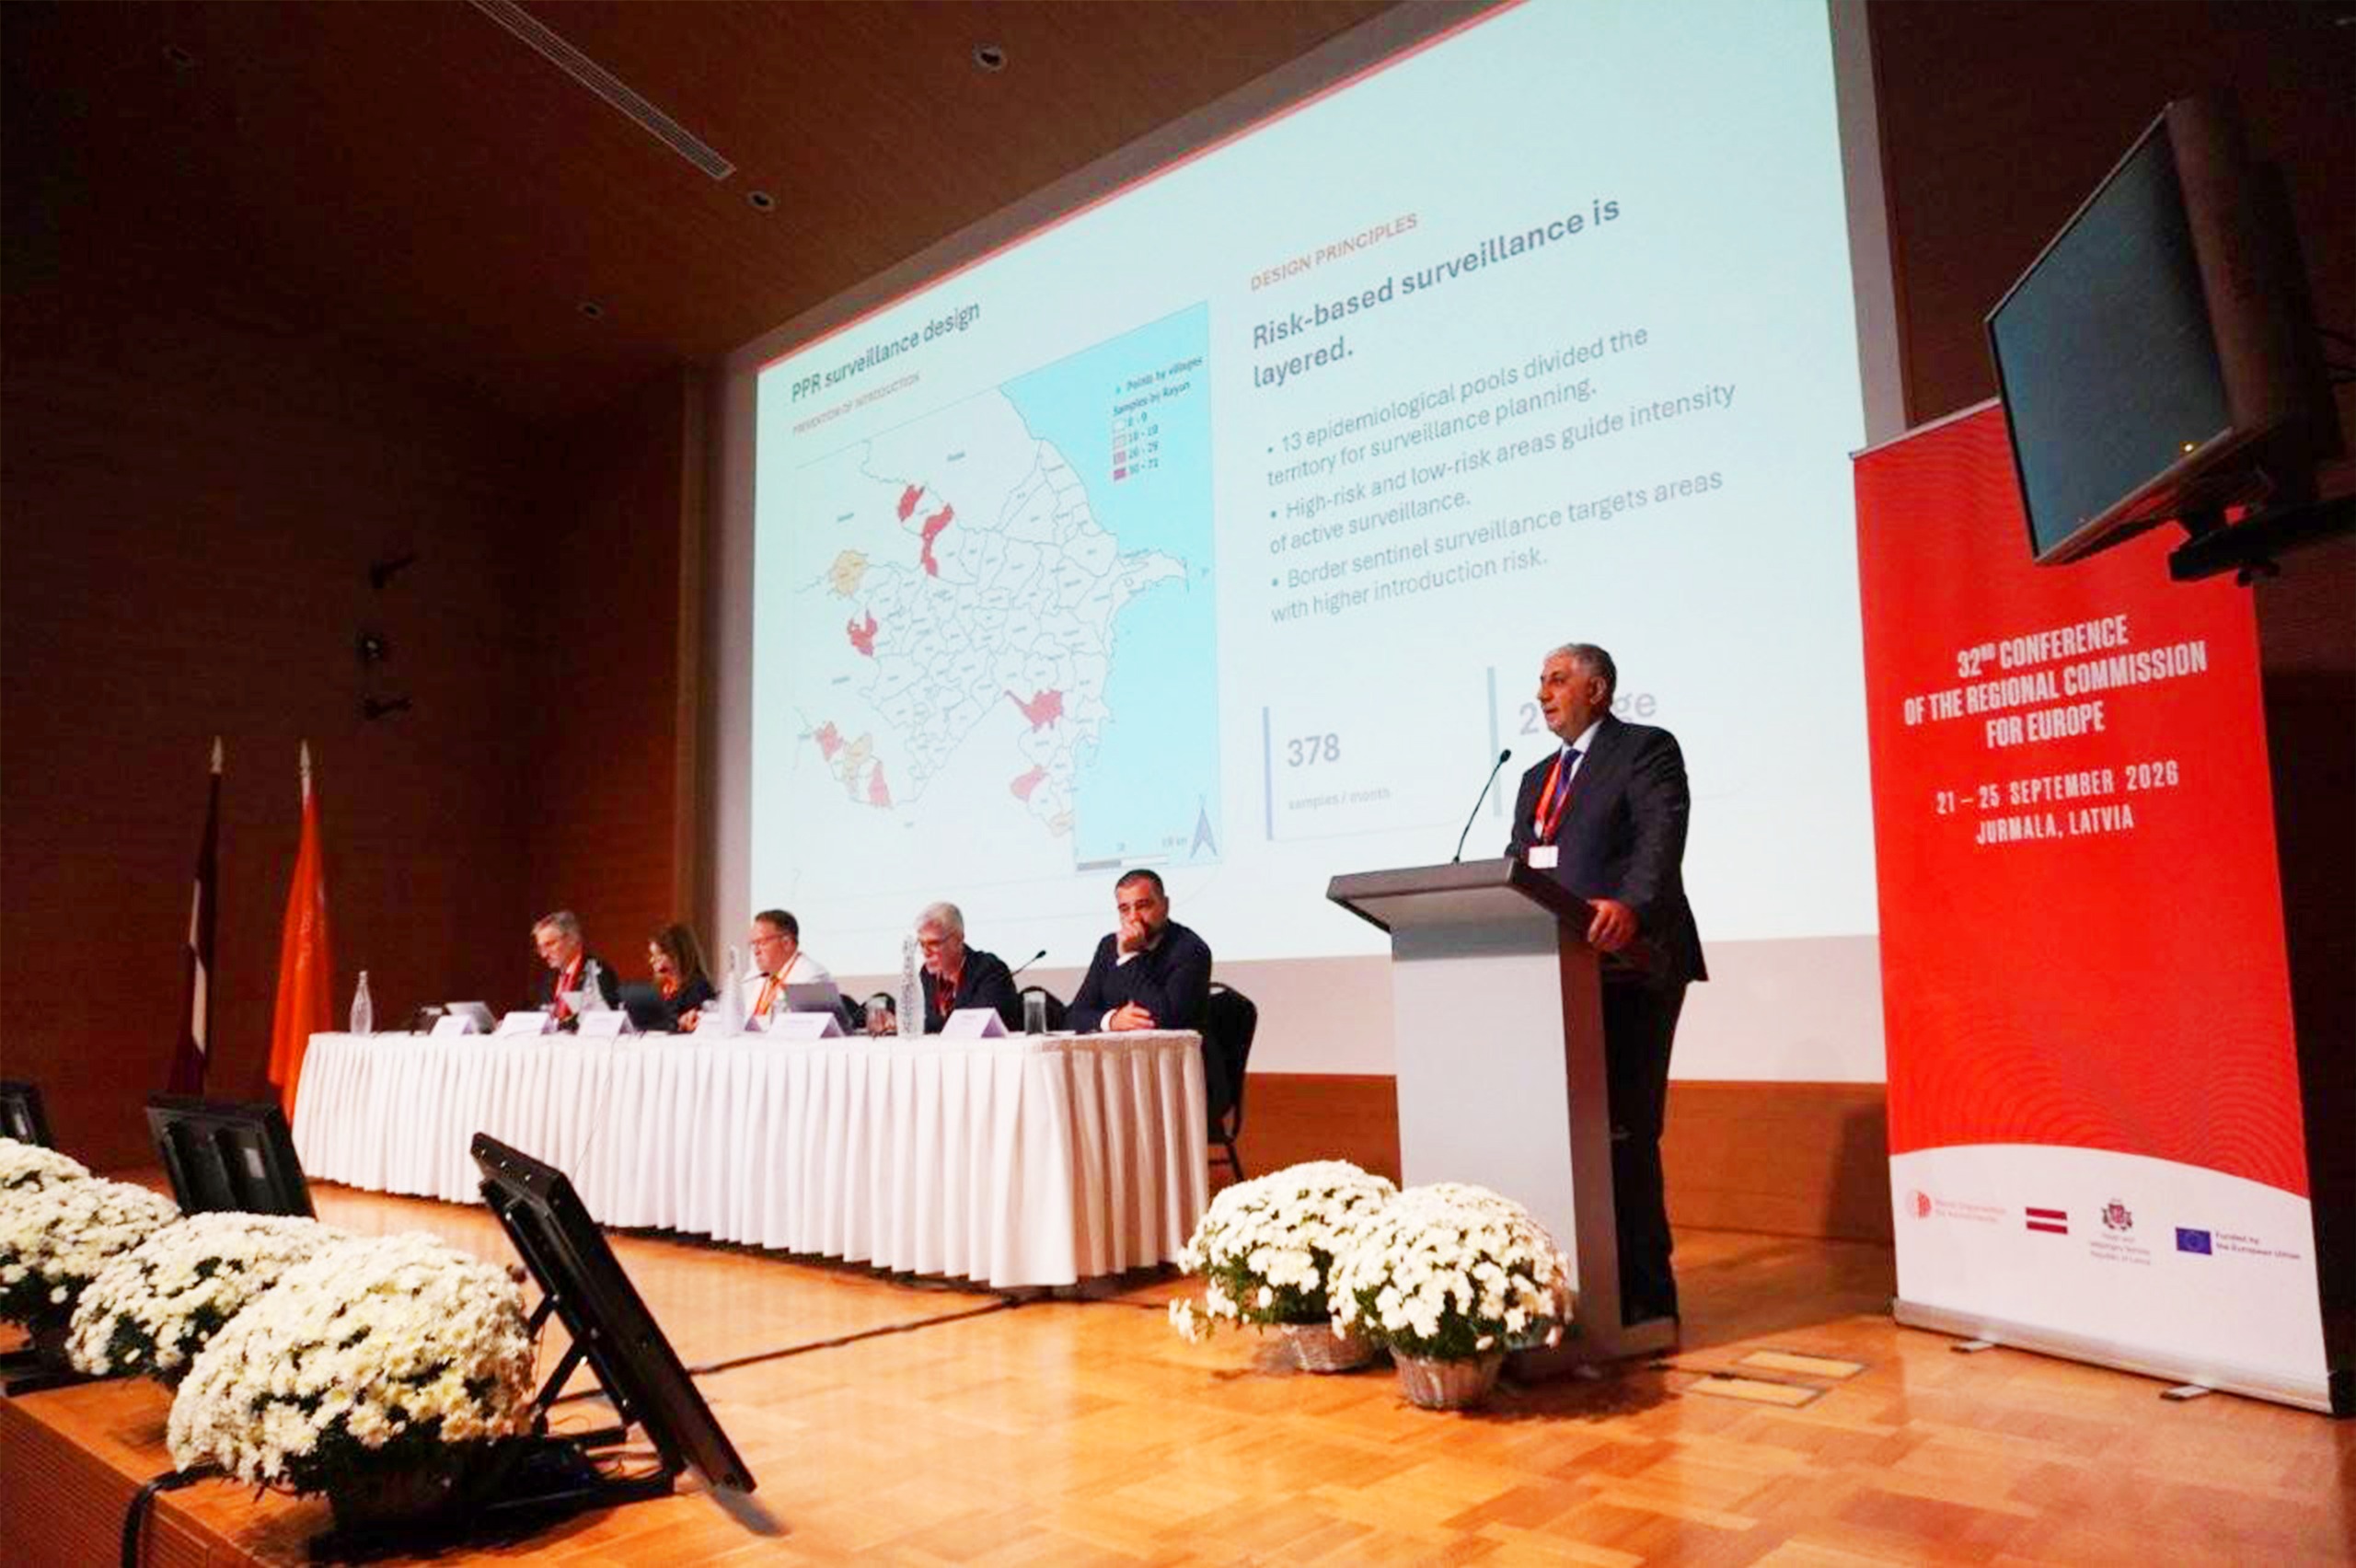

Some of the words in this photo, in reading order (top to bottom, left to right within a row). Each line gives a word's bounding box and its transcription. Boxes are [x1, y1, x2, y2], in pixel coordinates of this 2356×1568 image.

[1251, 255, 1311, 291] DESIGN
[1315, 213, 1417, 265] PRINCIPLES
[1253, 277, 1392, 349] Risk-based
[1402, 214, 1583, 294] surveillance
[1594, 201, 1619, 225] is
[791, 373, 821, 402] PPR
[825, 332, 918, 386] surveillance
[924, 303, 979, 341] design
[1254, 335, 1353, 387] layered.
[1282, 432, 1301, 452] 13
[1306, 383, 1455, 446] epidemiological
[1461, 367, 1519, 403] pools
[1524, 338, 1603, 379] divided
[1609, 329, 1647, 352] the
[1267, 455, 1336, 486] territory
[1340, 445, 1366, 465] for
[1370, 409, 1489, 456] surveillance
[1496, 377, 1596, 426] planning.
[1287, 482, 1366, 518] High-risk
[1371, 470, 1406, 497] and
[1411, 449, 1491, 485] low-risk
[1496, 433, 1555, 463] areas
[1562, 414, 1623, 450] guide
[1630, 385, 1735, 427] intensity
[1270, 535, 1287, 554] of
[1290, 524, 1343, 548] active
[1349, 492, 1471, 534] surveillance.
[1288, 559, 1347, 588] Border
[1352, 537, 1428, 572] sentinel
[1434, 510, 1562, 553] surveillance
[1568, 490, 1647, 522] targets
[1655, 471, 1723, 502] areas
[1271, 600, 1308, 622] with
[1313, 588, 1369, 615] higher
[1375, 559, 1496, 600] introduction
[1503, 546, 1547, 572] risk.
[2000, 615, 2128, 668] CONFERENCE
[1905, 697, 1923, 725] OF
[1929, 689, 1962, 720] THE
[1967, 671, 2059, 713] REGIONAL
[2063, 641, 2205, 695] COMMISSION
[1288, 732, 1340, 767] 378
[1987, 716, 2023, 747] FOR
[2027, 701, 2104, 741] EUROPE
[1288, 794, 1339, 810] samples
[1350, 787, 1391, 802] month
[1937, 791, 1954, 813] 21
[1979, 784, 1999, 808] 25
[2010, 769, 2113, 804] SEPTEMBER
[2126, 760, 2177, 790] 2026
[1977, 813, 2062, 844] JURMALA,
[2069, 804, 2133, 834] LATVIA
